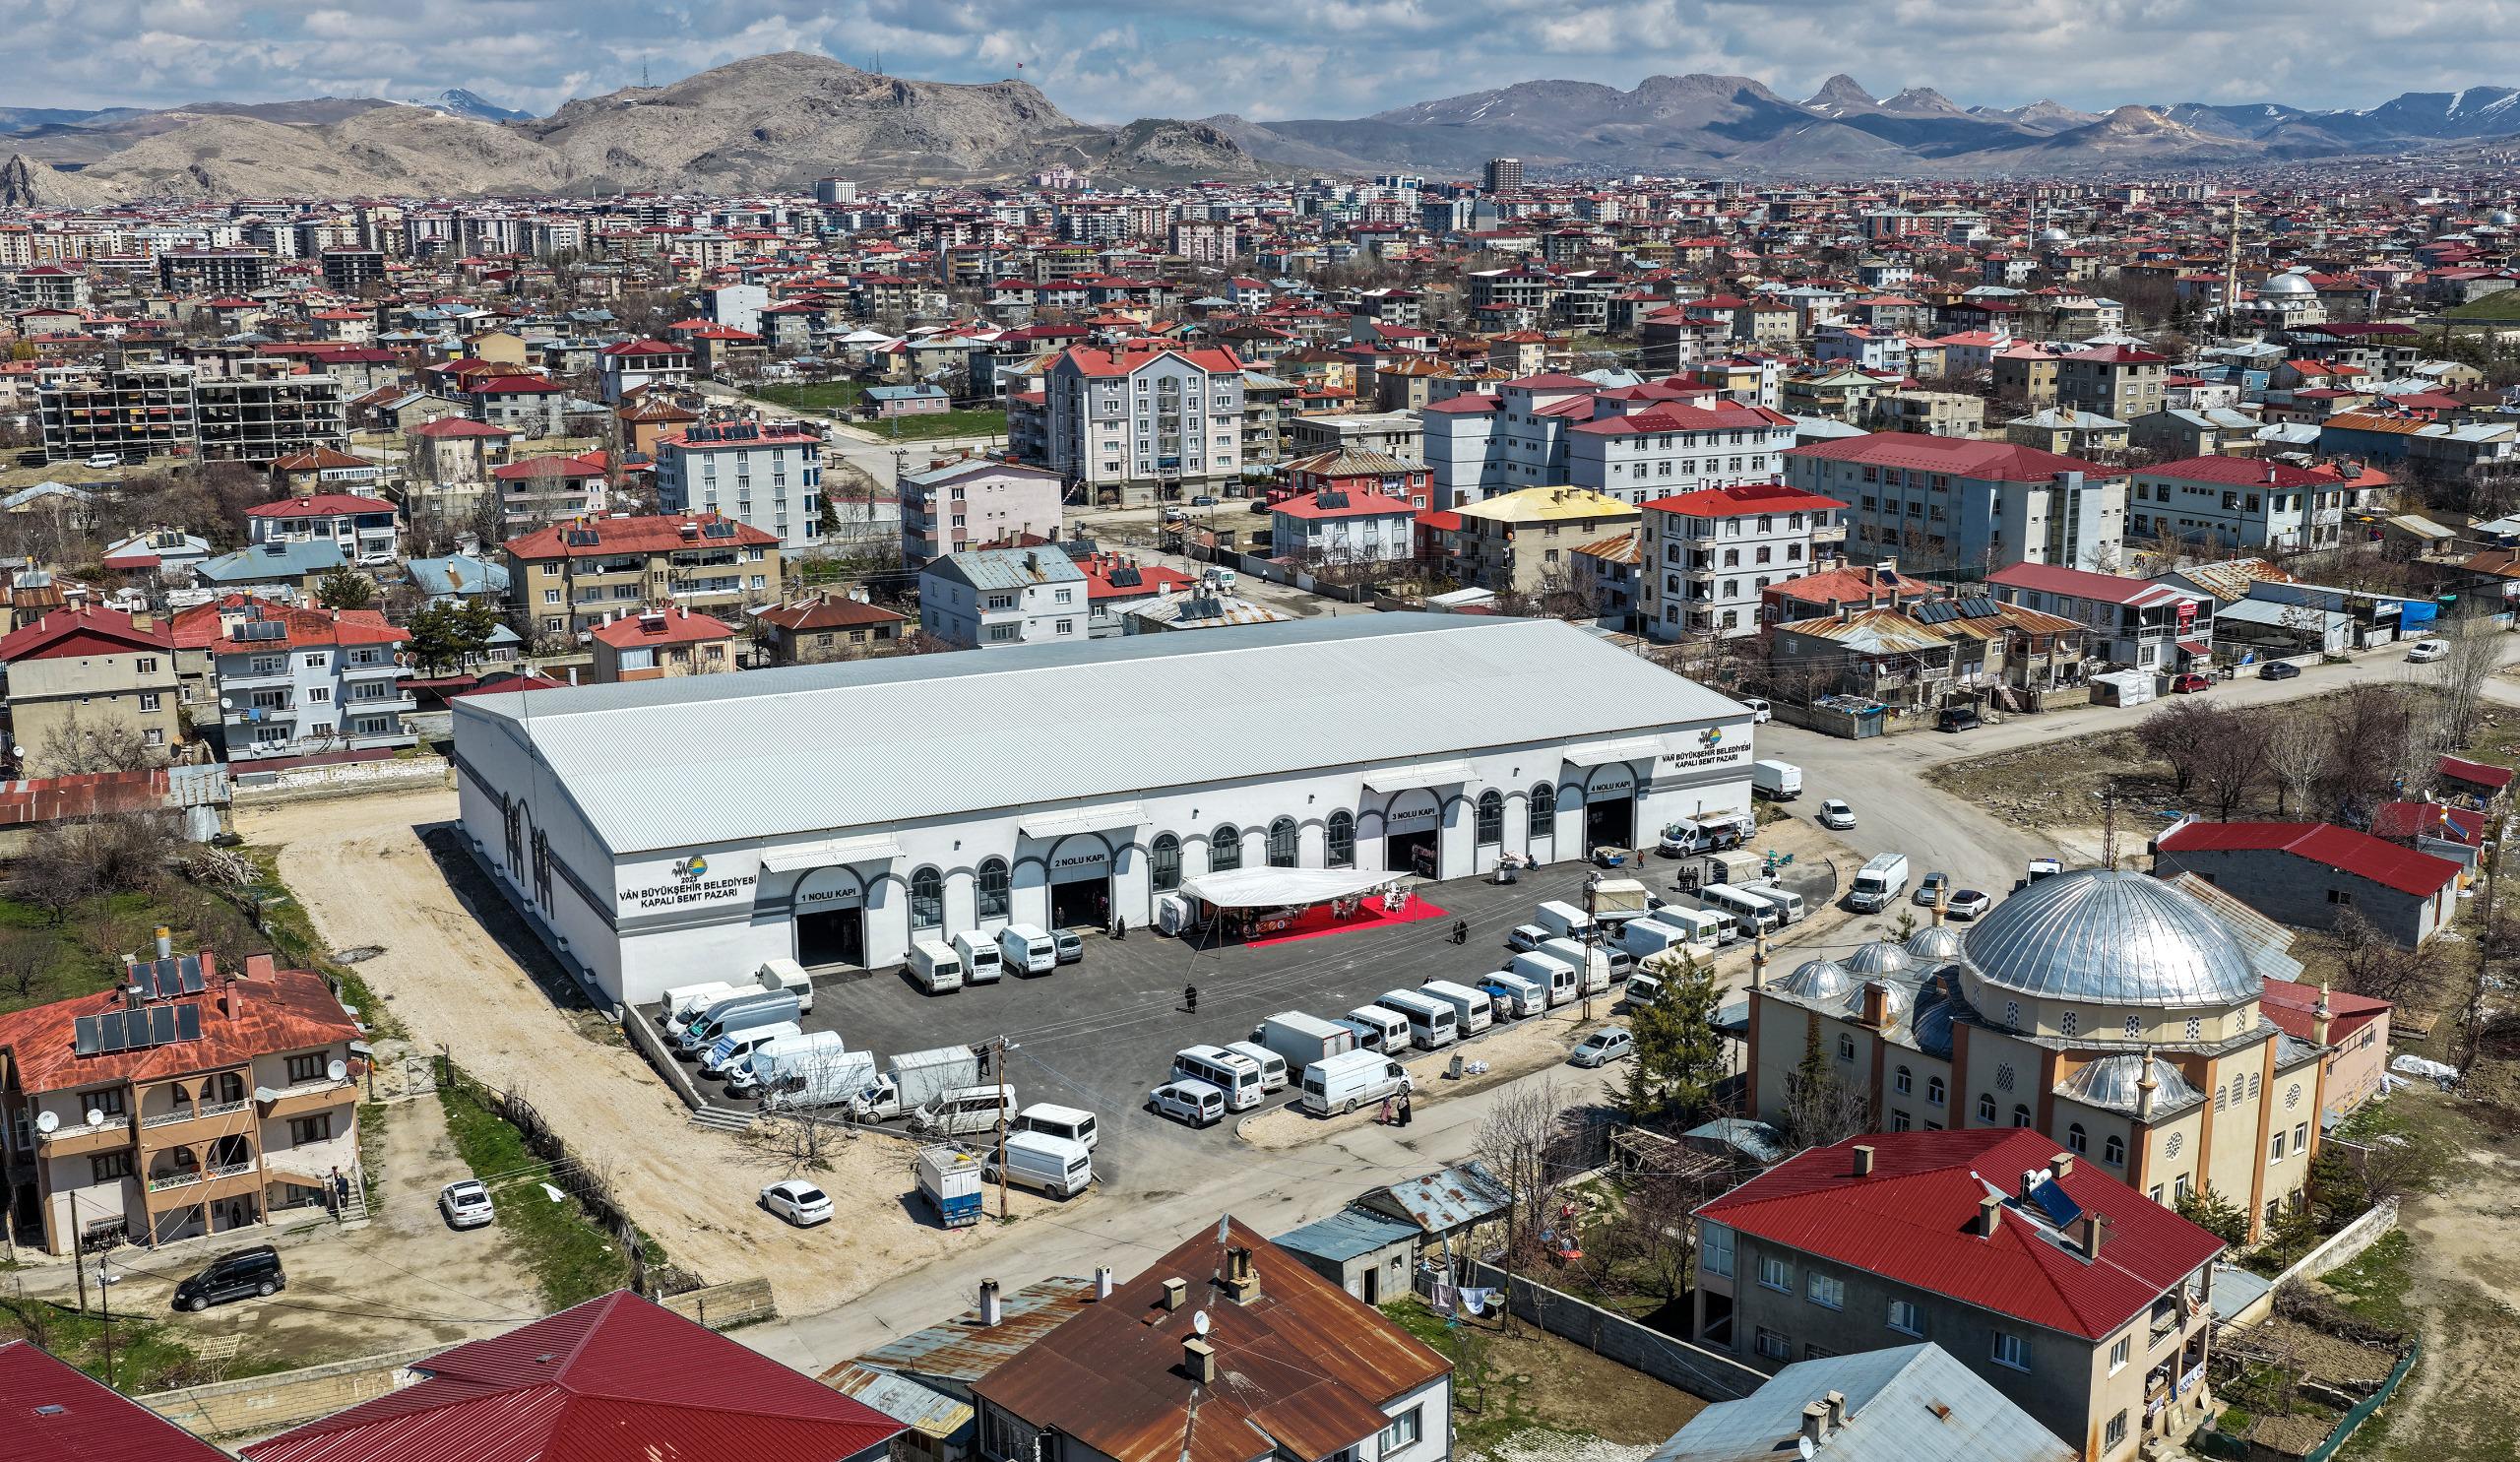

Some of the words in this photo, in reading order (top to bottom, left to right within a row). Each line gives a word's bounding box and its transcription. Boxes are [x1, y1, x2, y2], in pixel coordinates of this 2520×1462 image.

[1675, 749, 1715, 760] BÜYÜKŞEHİR
[1716, 743, 1750, 754] BELEDİYESİ
[1675, 759, 1697, 768] KAPALI
[1716, 754, 1737, 763] PAZARI
[1398, 810, 1417, 819] NOLU
[1418, 807, 1434, 816] KAPI
[1062, 857, 1084, 865] NOLU
[1086, 854, 1104, 862] KAPI
[641, 882, 701, 898] BÜYÜKŞEHİR
[705, 874, 757, 890] BELEDİYESİ
[641, 897, 674, 908] KAPALI
[677, 894, 702, 904] SEMT
[705, 888, 737, 900] PAZARI
[809, 891, 833, 901] NOLU
[836, 888, 856, 897] KAPI
